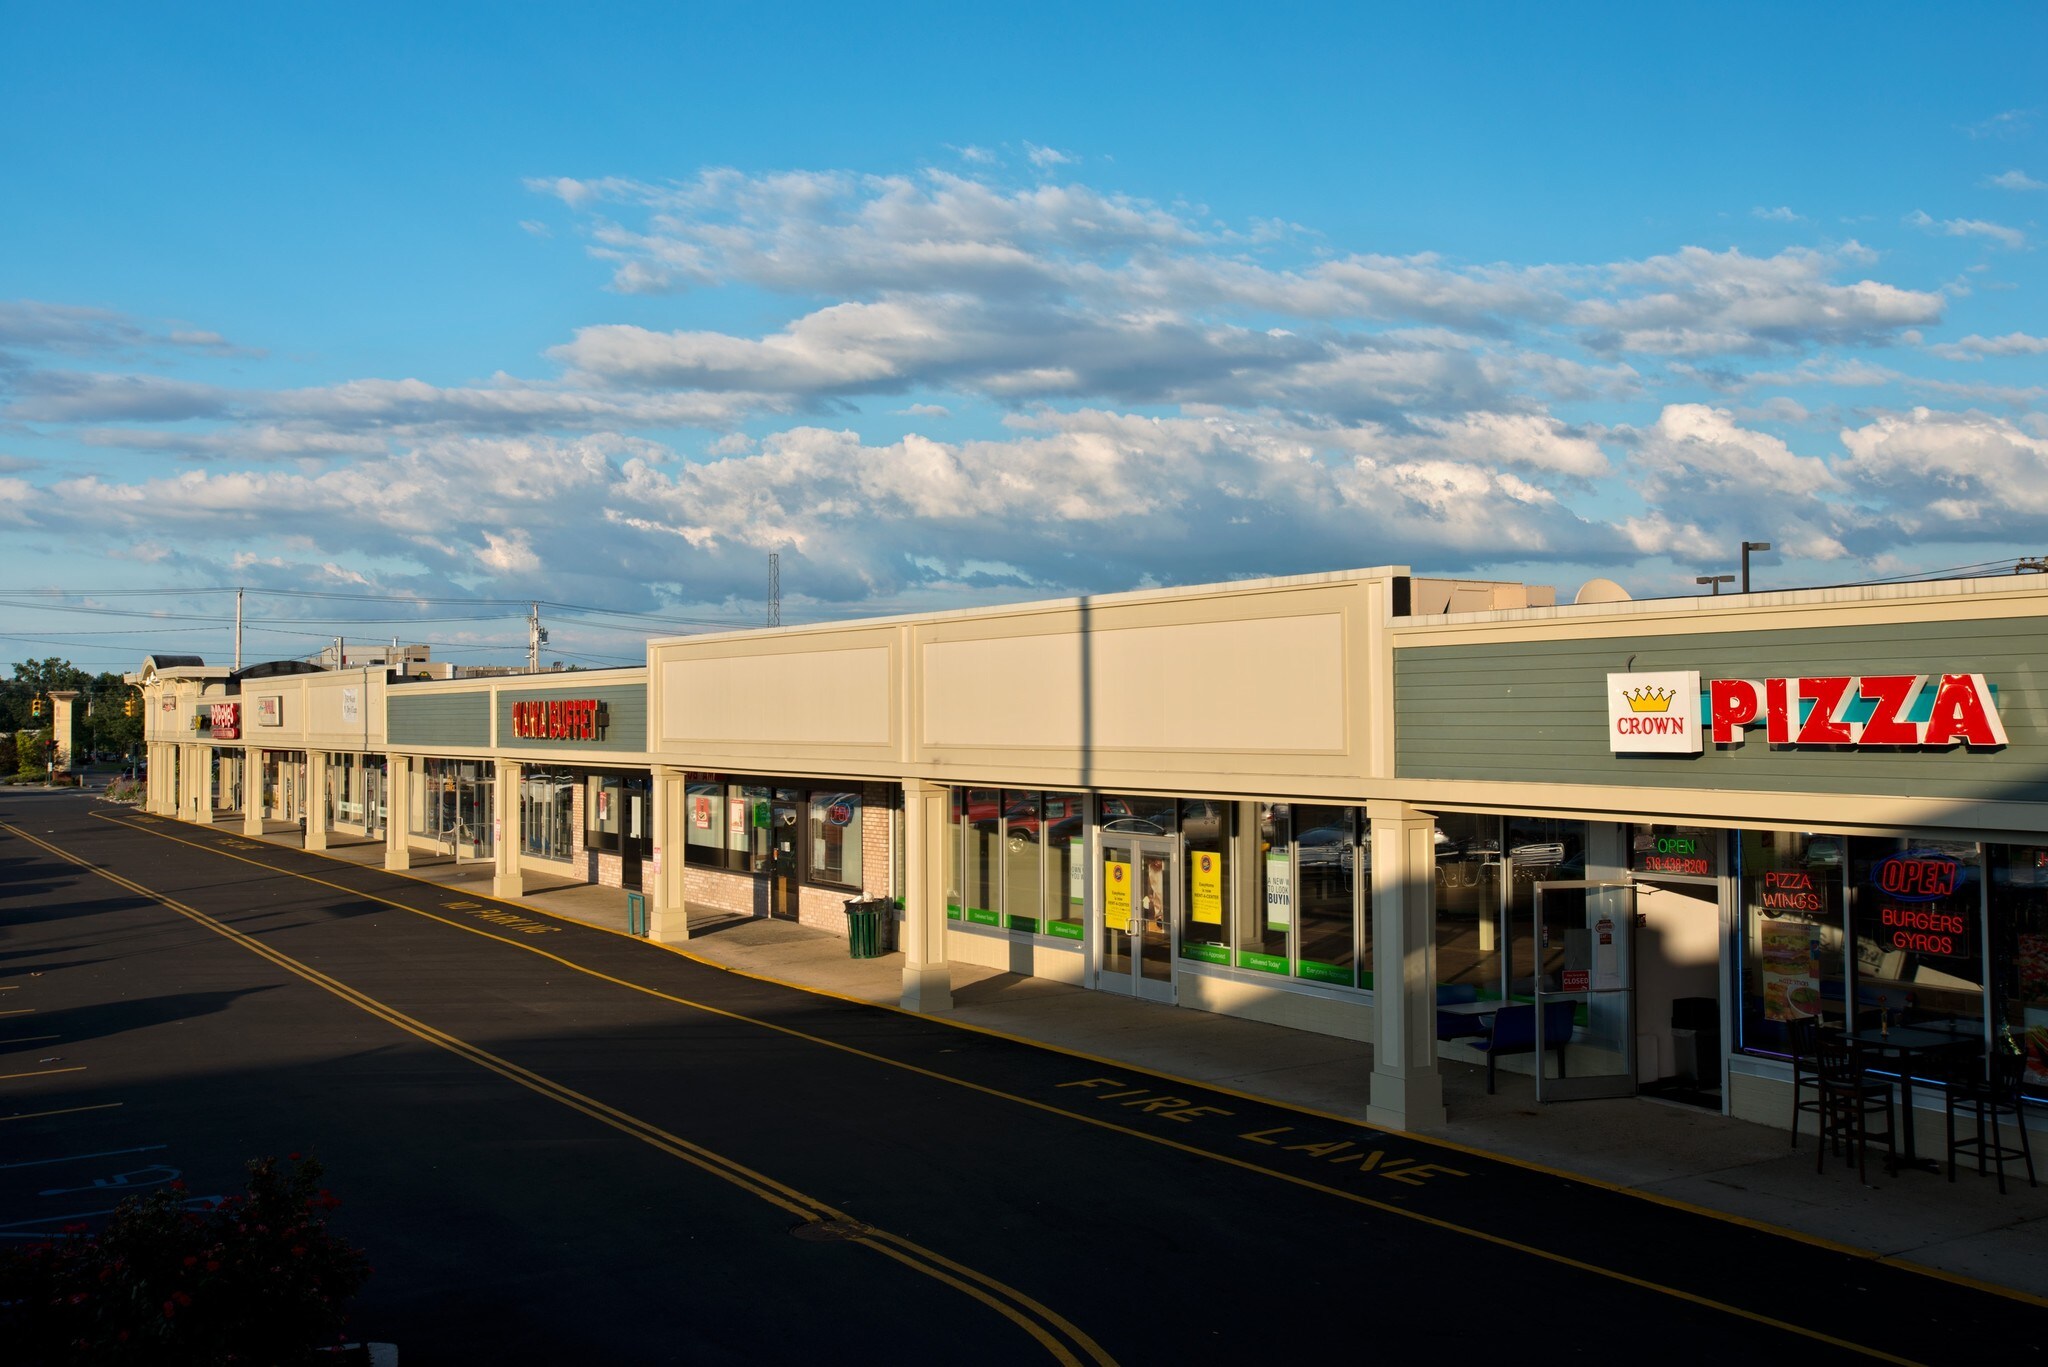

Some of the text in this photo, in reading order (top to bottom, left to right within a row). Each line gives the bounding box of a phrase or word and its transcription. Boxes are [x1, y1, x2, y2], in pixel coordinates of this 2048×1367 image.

[549, 699, 598, 739] BUFFET
[1710, 674, 2006, 746] PIZZA
[1617, 716, 1684, 736] CROWN
[1657, 838, 1695, 854] OPEN
[1645, 856, 1709, 874] 518-438-8200
[1765, 871, 1813, 890] PIZZA
[1882, 858, 1957, 896] OPEN
[1762, 891, 1819, 911] WINGS
[439, 900, 562, 935] NO PARKING
[1881, 908, 1964, 935] BURGERS
[1893, 930, 1953, 955] GYROS
[1250, 958, 1268, 966] Delivered
[1564, 977, 1588, 985] CLOSED
[1055, 1077, 1472, 1187] FIRE LANE
